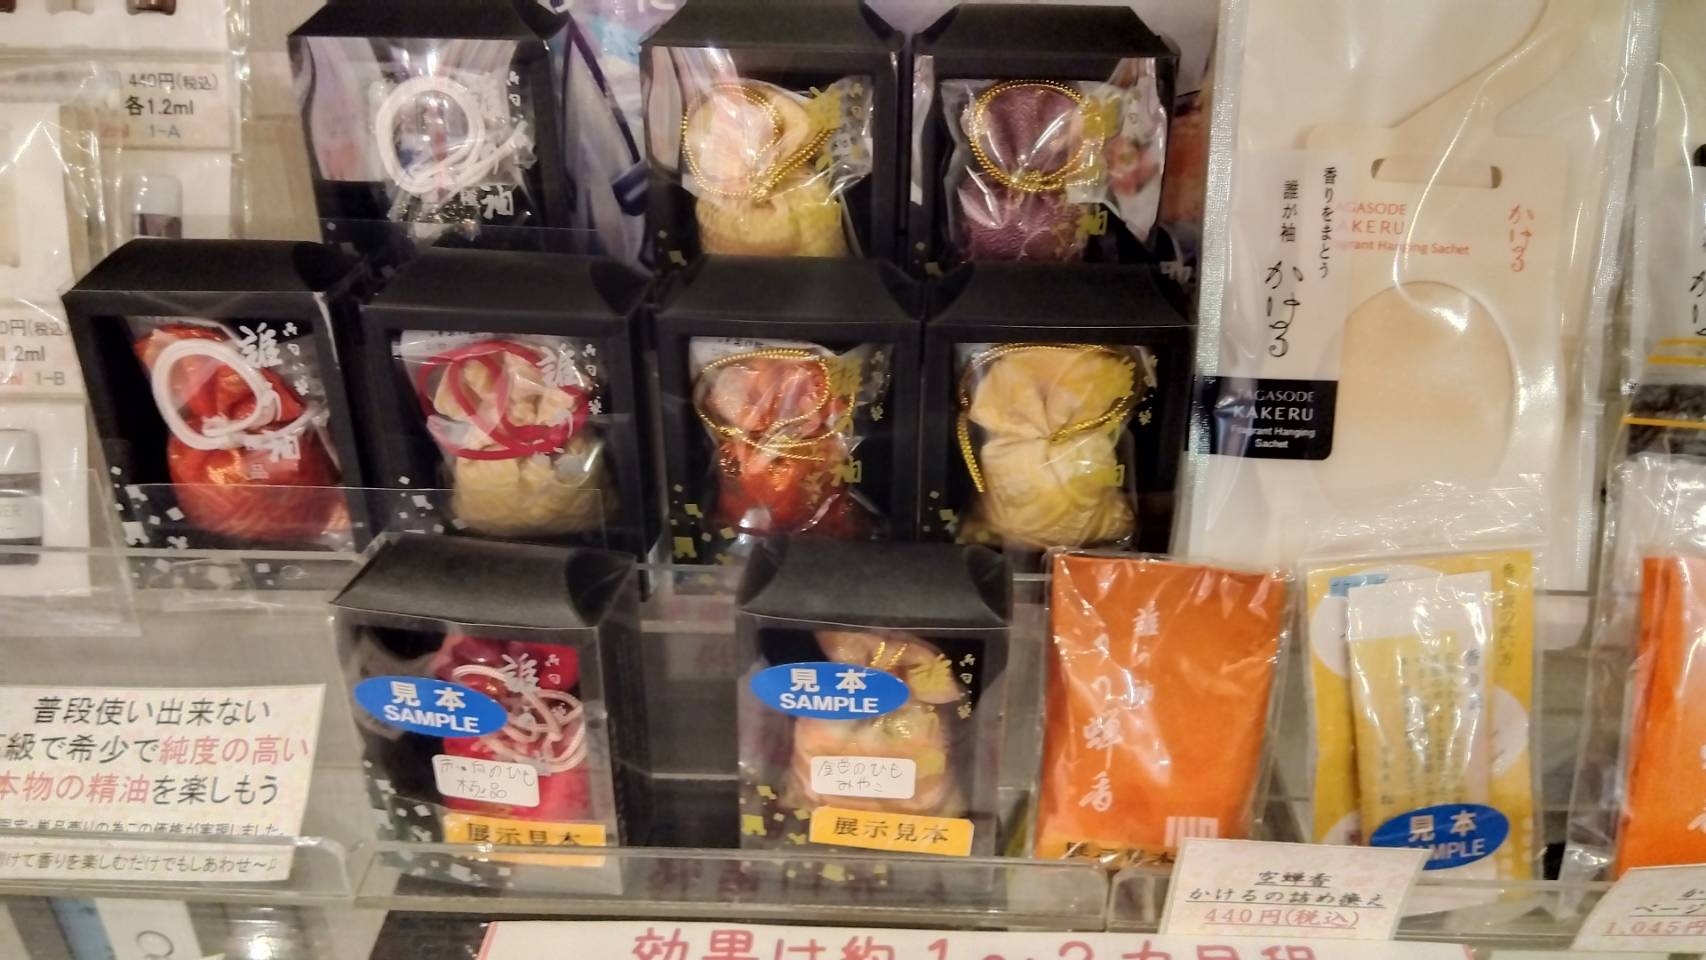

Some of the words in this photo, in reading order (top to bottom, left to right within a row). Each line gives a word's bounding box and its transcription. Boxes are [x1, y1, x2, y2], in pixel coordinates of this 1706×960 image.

[125, 97, 194, 116] 各1.2ml
[1320, 166, 1337, 279] 香りをまとう
[1254, 438, 1290, 449] Sachet
[789, 667, 868, 694] 見本
[33, 696, 272, 726] 普段使い出来ない
[390, 680, 467, 712] 見本
[779, 692, 880, 714] SAMPLE
[383, 704, 481, 734] SAMPLE
[0, 733, 310, 766] 級で希少で純度の高い
[833, 815, 950, 845] 展示見本
[1203, 908, 1361, 929] 440円(税込)
